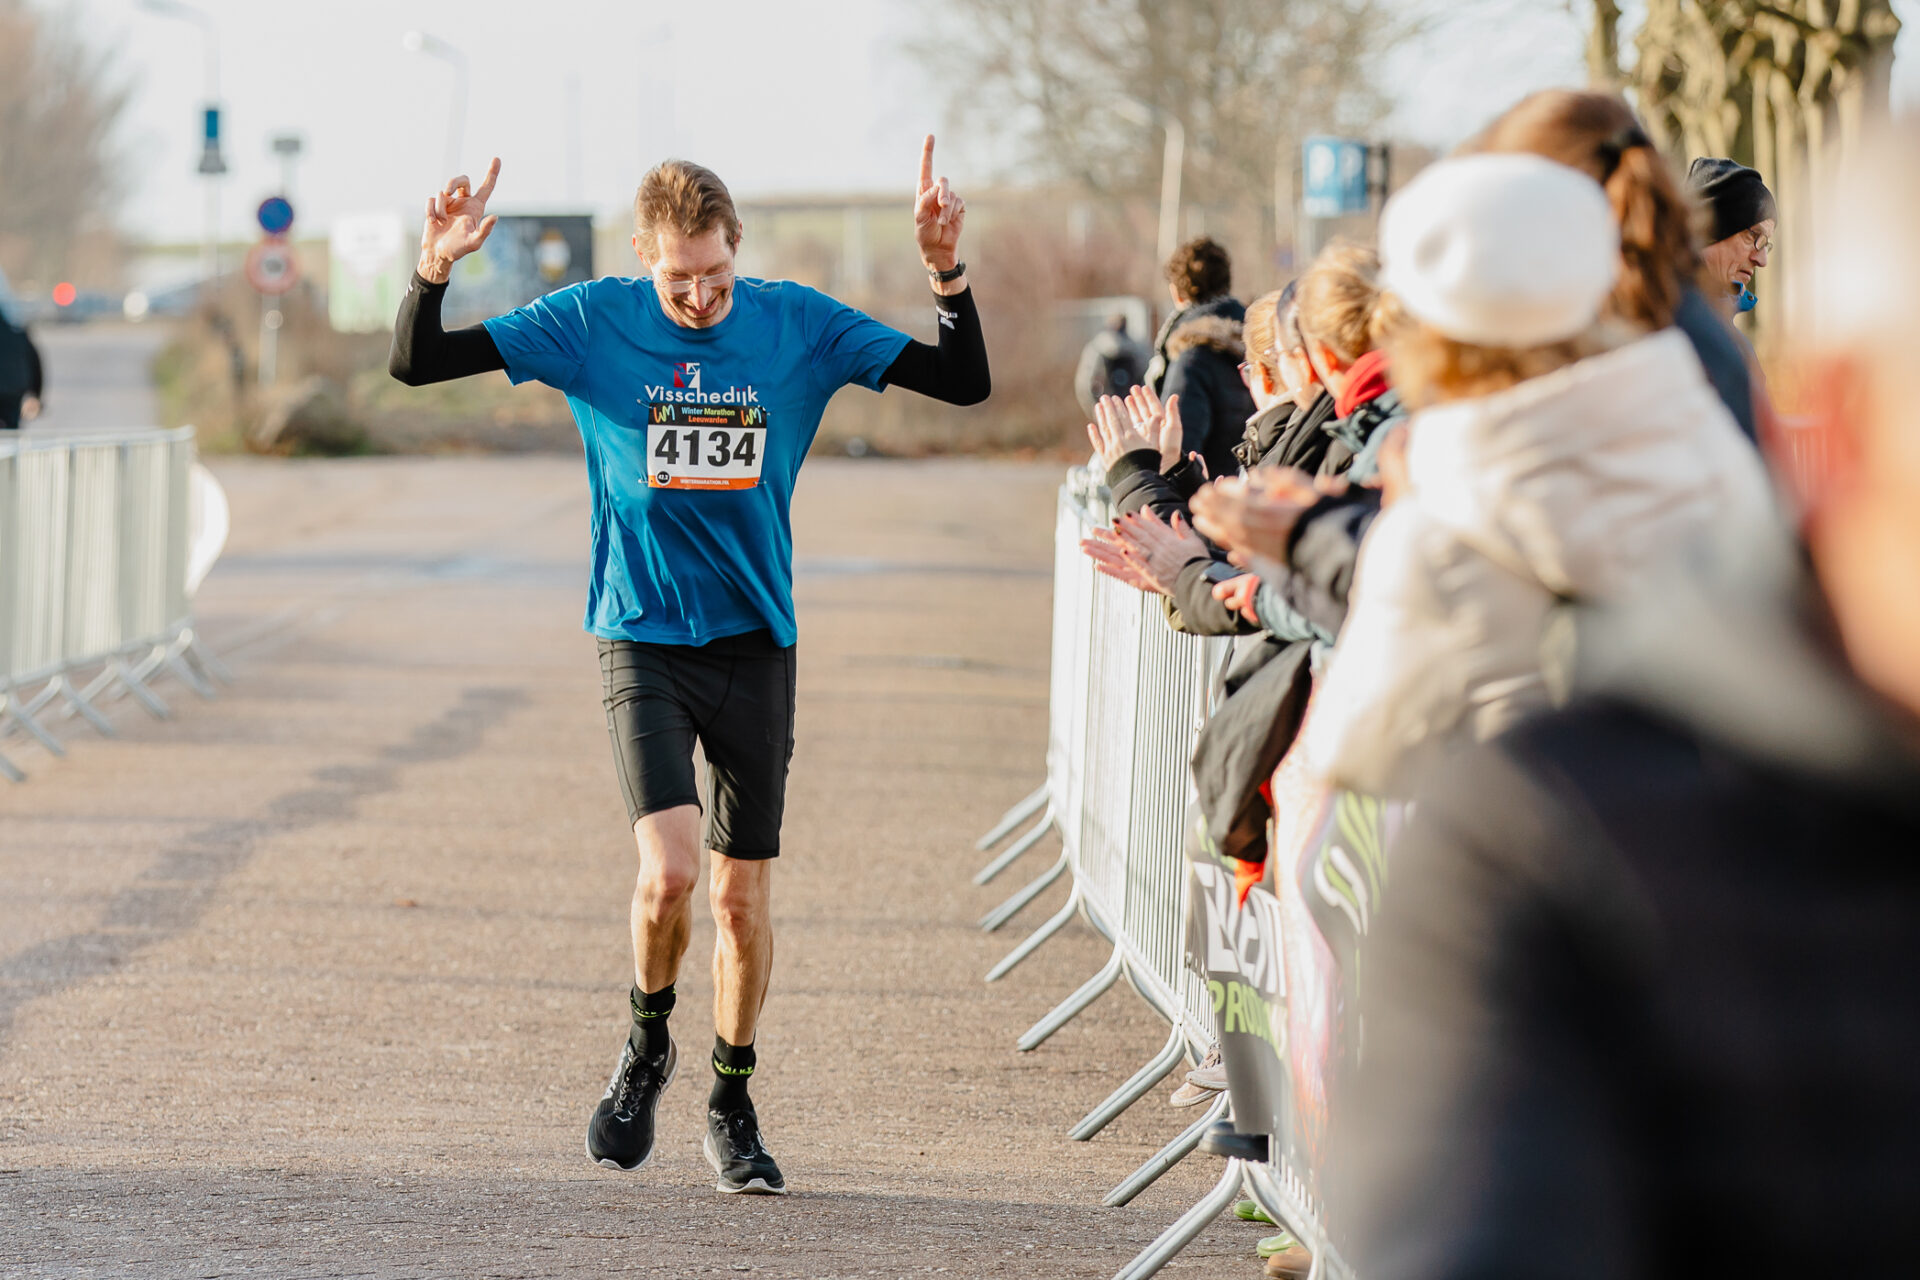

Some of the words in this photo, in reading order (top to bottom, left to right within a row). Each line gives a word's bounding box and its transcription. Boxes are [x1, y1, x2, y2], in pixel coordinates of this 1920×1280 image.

[644, 384, 759, 406] Visschedijk
[681, 406, 703, 415] Winter
[703, 408, 736, 416] Marathon
[688, 415, 728, 424] Leeuwarden
[654, 429, 756, 467] 4134
